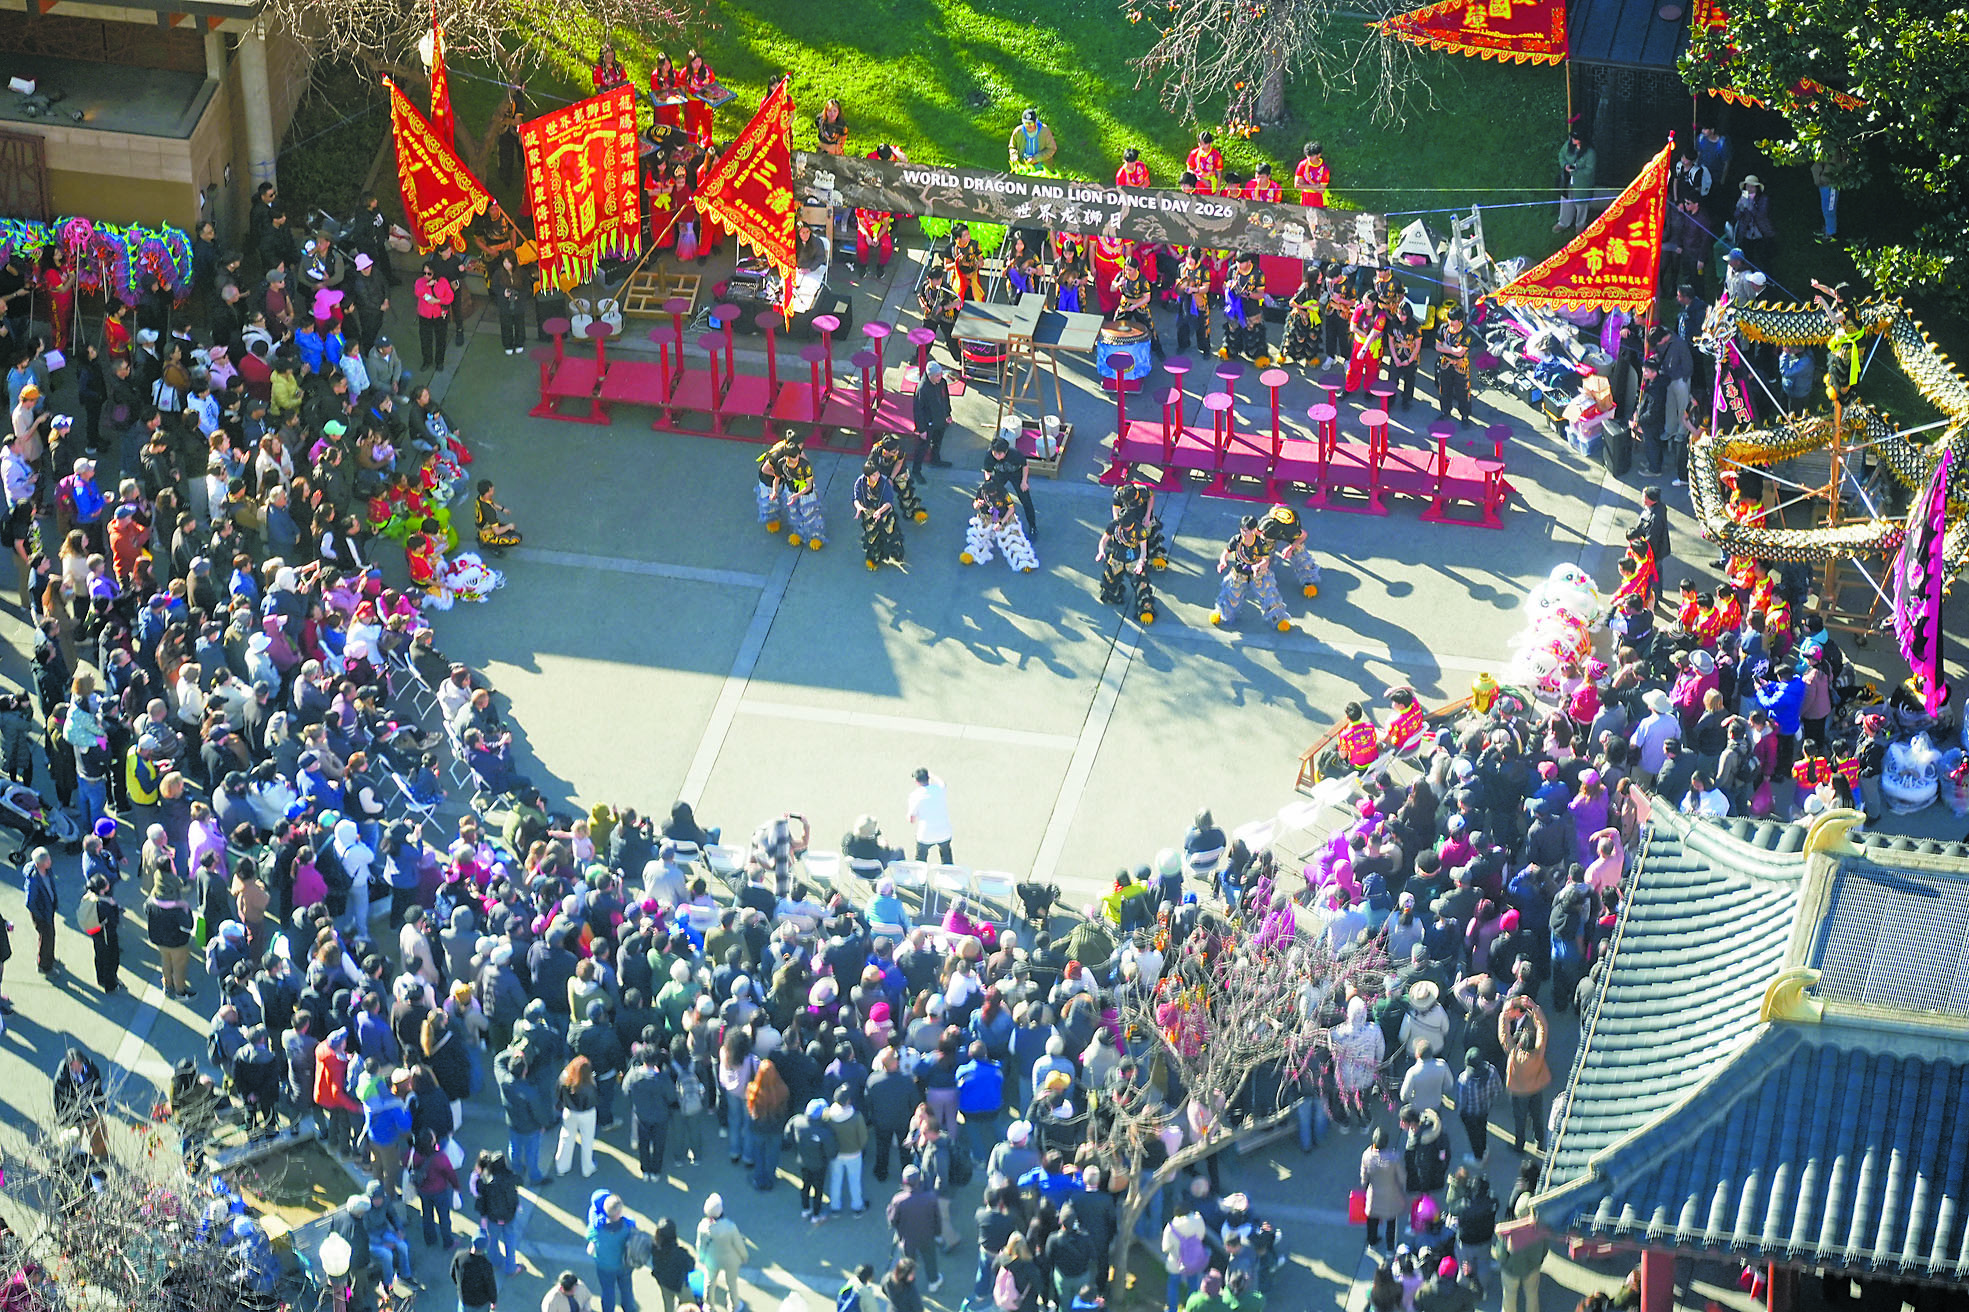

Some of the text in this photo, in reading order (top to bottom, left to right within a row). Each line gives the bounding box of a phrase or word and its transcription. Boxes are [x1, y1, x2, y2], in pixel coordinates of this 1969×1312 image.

[903, 170, 1234, 218] WORLD DRAGON AND LION DANCE DAY 2026
[1014, 202, 1121, 229] 世界龙狮日
